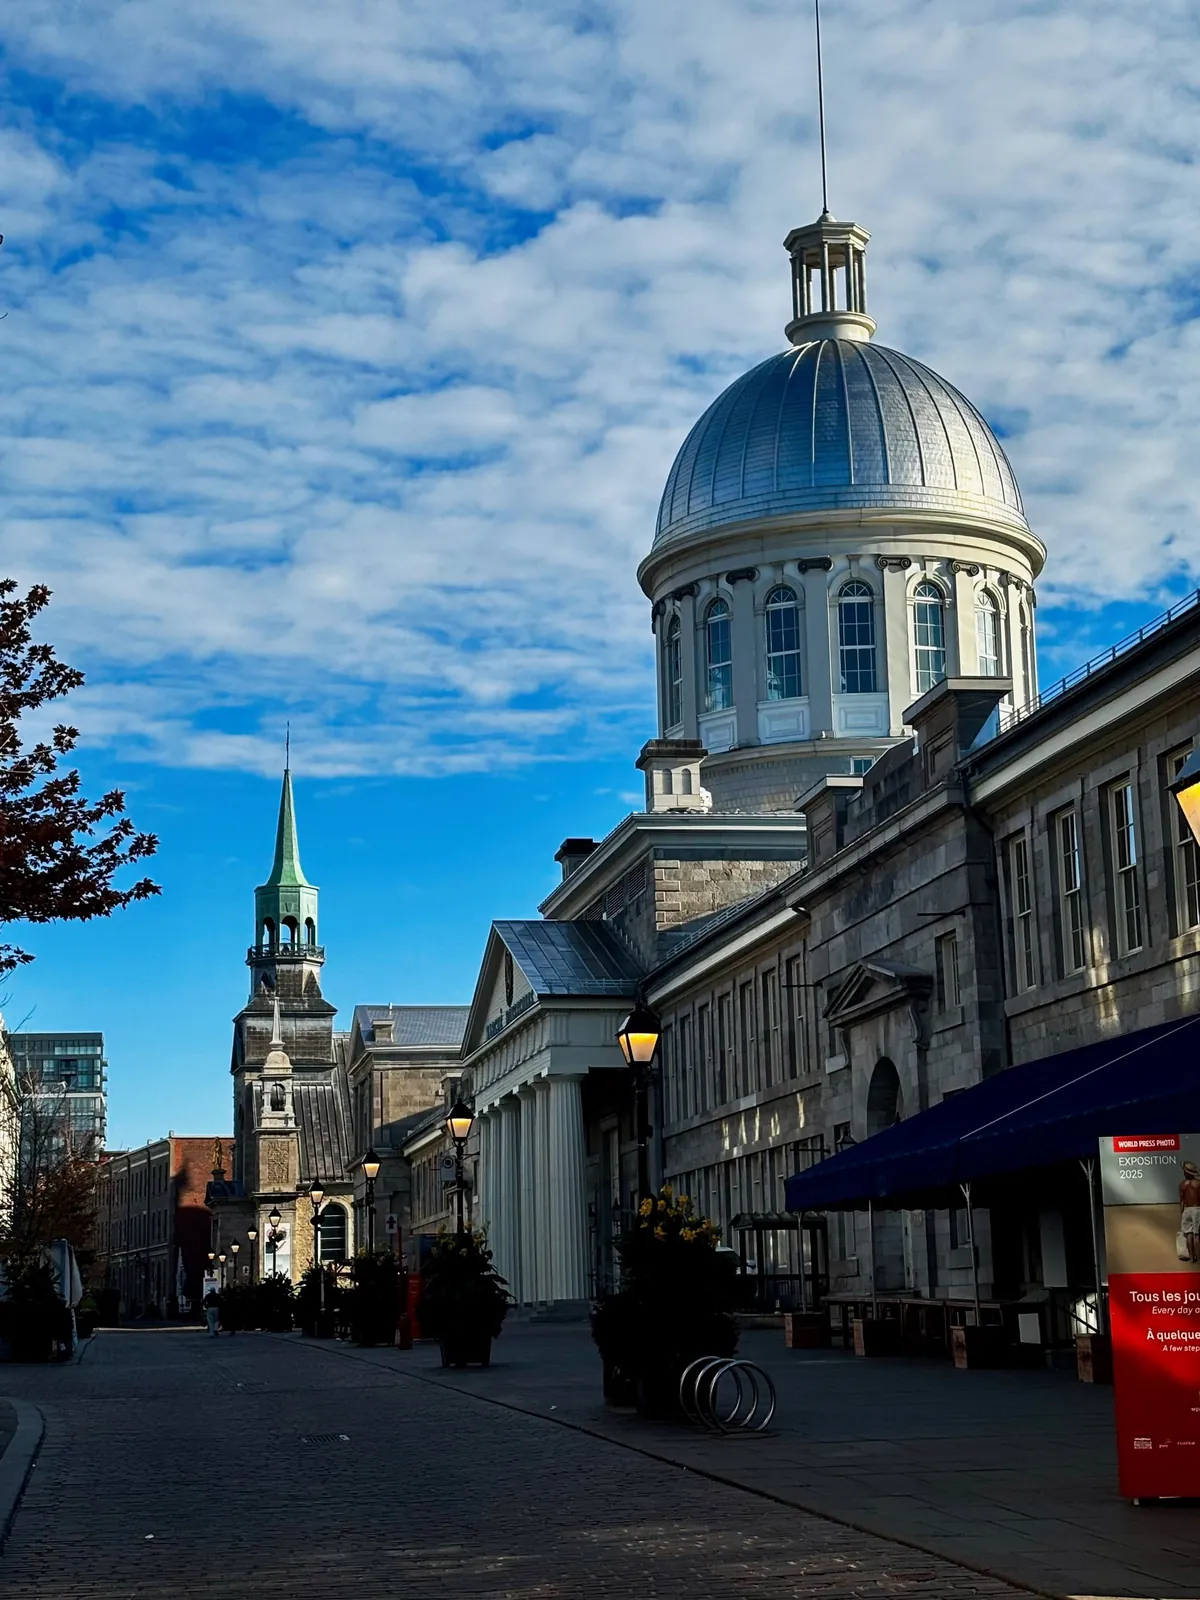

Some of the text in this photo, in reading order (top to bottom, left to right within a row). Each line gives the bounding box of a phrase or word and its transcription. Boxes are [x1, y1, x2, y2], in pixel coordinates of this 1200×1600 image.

[1118, 1156, 1176, 1166] EXPOSITION
[1120, 1170, 1143, 1179] 2025
[1129, 1291, 1160, 1302] Tous
[1162, 1290, 1181, 1302] les
[1152, 1306, 1176, 1316] Every
[1177, 1306, 1193, 1316] day
[1147, 1328, 1200, 1342] À quelque
[1184, 1345, 1200, 1353] step
